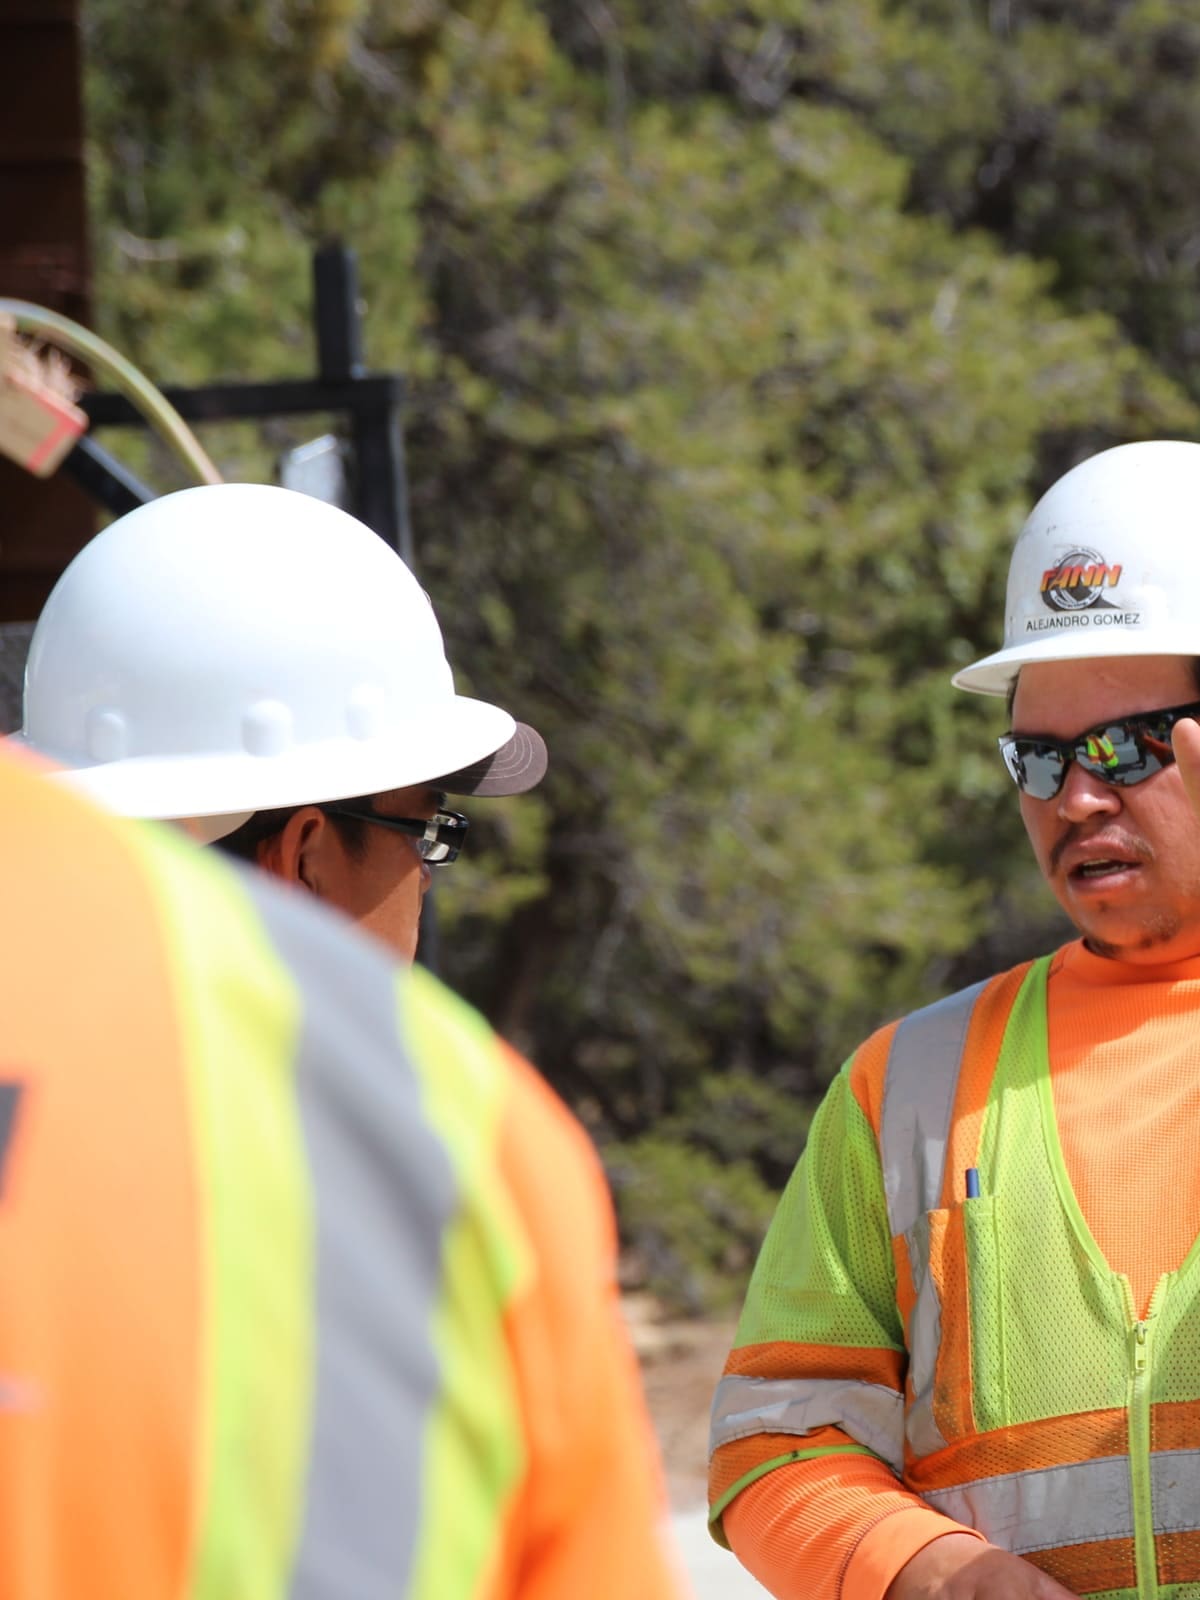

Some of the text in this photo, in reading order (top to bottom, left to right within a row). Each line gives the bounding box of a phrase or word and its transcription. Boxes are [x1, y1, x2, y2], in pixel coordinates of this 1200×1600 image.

[1041, 564, 1121, 592] FANN
[1027, 613, 1140, 631] ALEJANDRO GOMEZ
